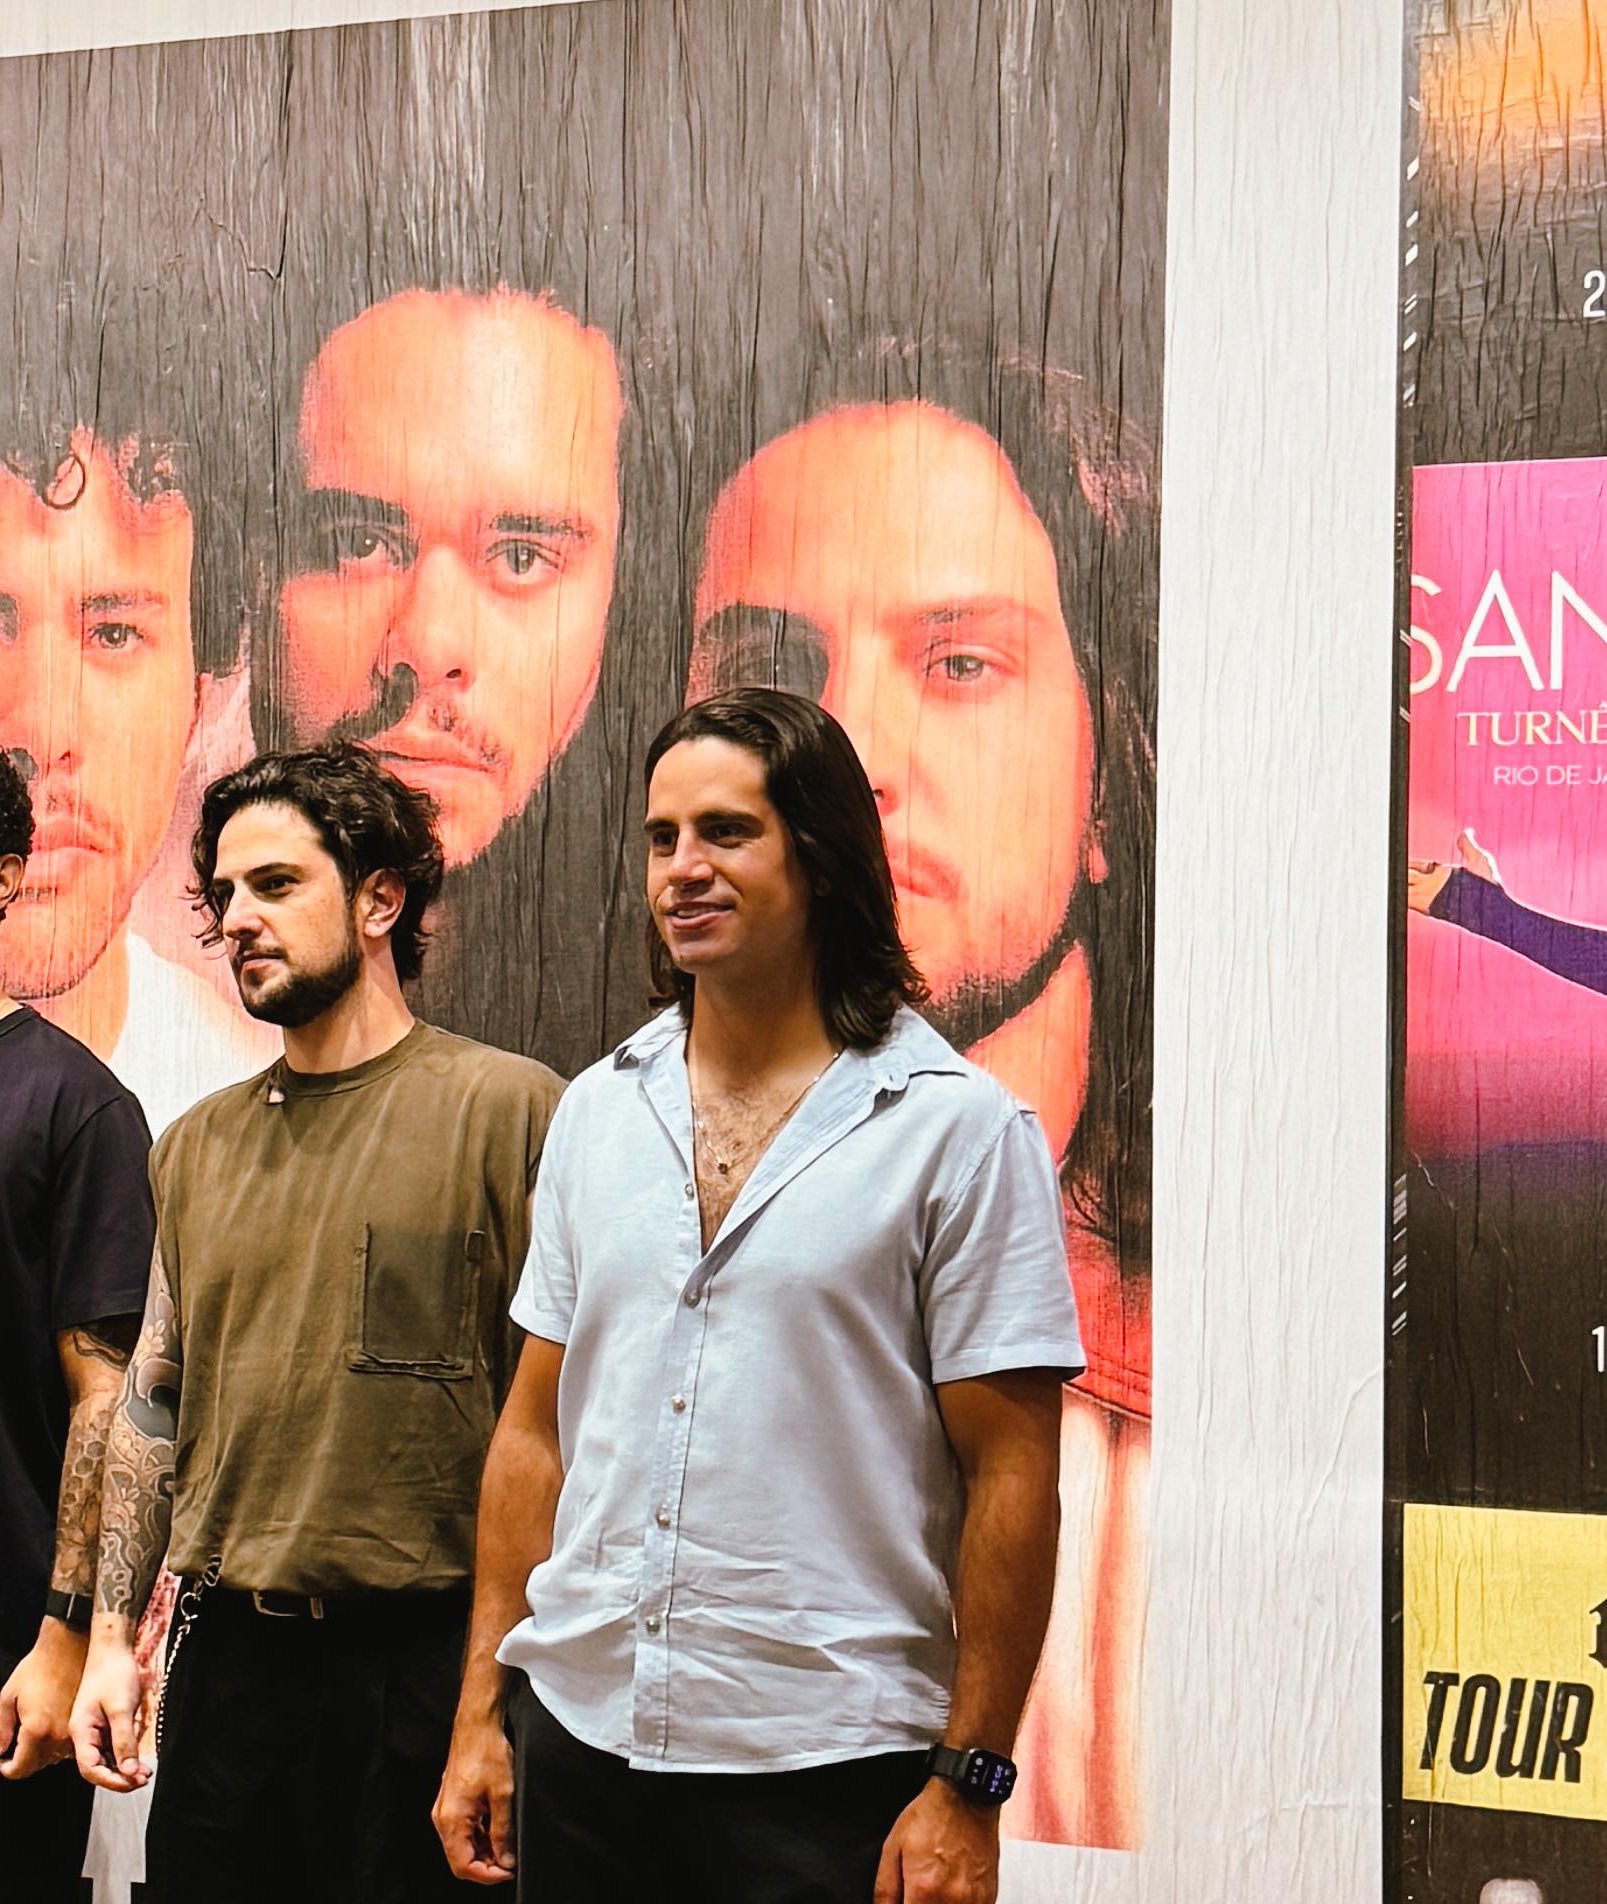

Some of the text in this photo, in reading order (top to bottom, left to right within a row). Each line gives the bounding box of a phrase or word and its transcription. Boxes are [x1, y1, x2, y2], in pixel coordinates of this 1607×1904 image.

[1493, 765, 1540, 786] RIO
[1546, 765, 1582, 786] DE
[1420, 1671, 1594, 1784] TOUR
